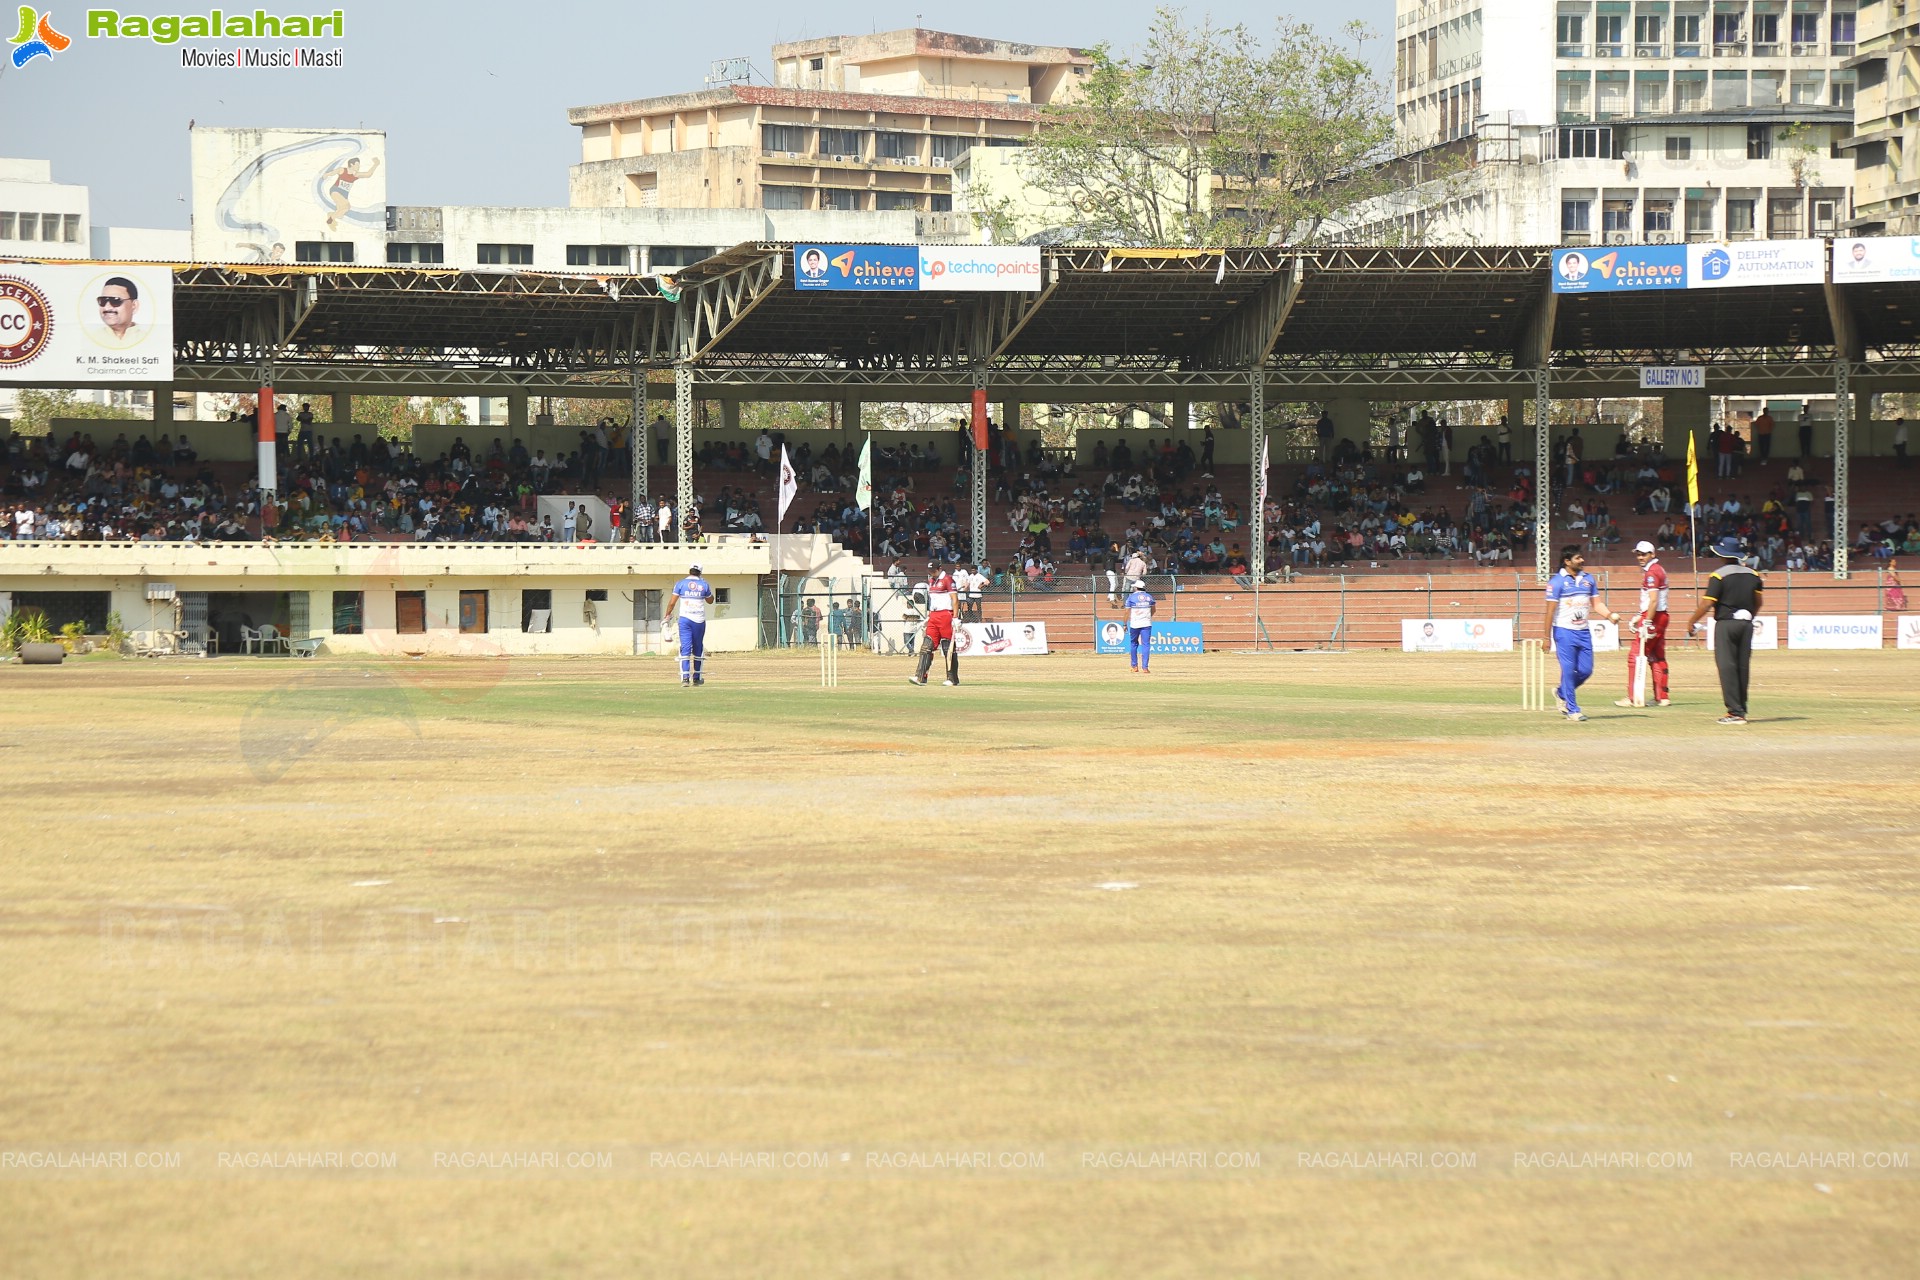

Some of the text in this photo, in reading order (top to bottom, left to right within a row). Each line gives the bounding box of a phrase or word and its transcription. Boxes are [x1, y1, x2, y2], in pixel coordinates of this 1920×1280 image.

[1737, 249, 1779, 259] DELPHY
[948, 259, 1039, 277] technopaints
[1737, 261, 1814, 272] AUTOMATION
[1616, 278, 1682, 286] ACADEMY
[21, 337, 36, 352] CUP
[76, 356, 85, 364] K.
[88, 356, 99, 364] M.
[102, 356, 139, 364] Shakeel
[87, 367, 149, 375] Chairman CCC
[1646, 369, 1699, 386] GALLERY NO 3
[1813, 626, 1878, 635] MURUGUN
